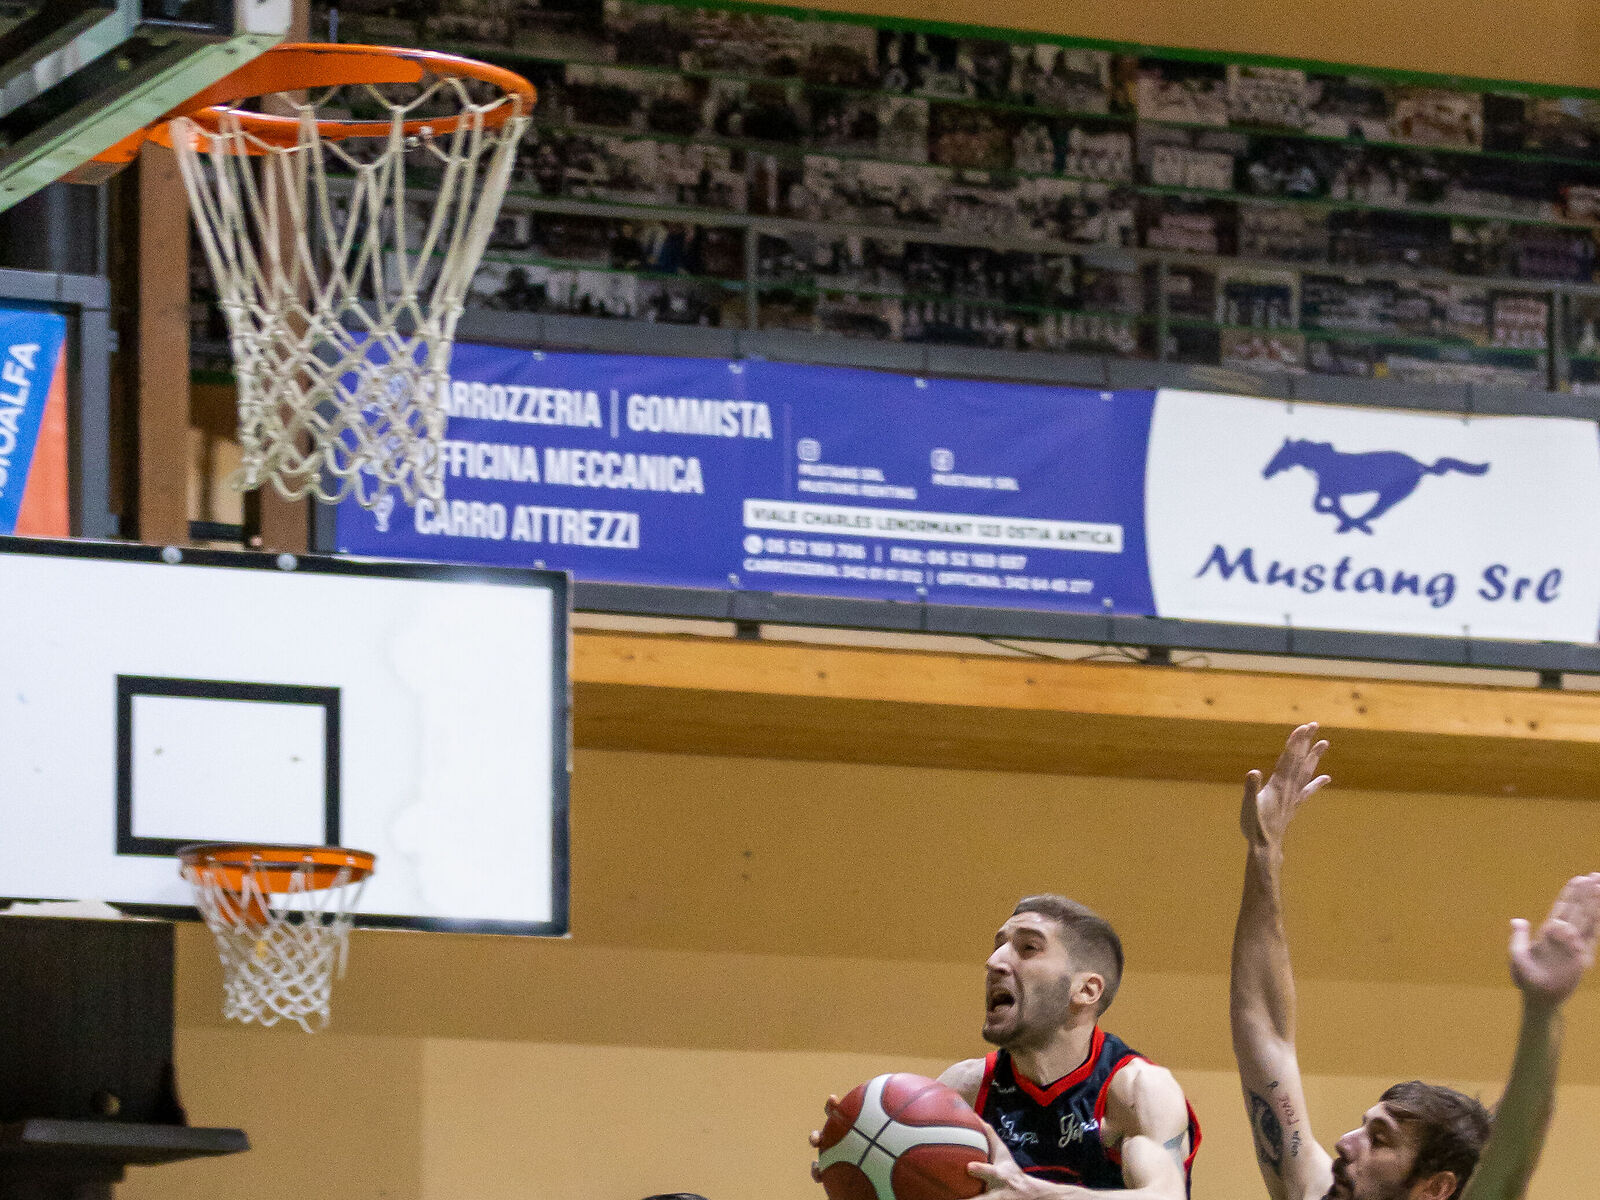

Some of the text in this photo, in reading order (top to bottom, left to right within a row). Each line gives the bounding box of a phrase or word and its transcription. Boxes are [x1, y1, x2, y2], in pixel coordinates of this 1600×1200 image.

[627, 394, 773, 439] GOMMISTA
[545, 449, 704, 494] MECCANICA
[415, 498, 640, 549] CARRO ATTREZZI
[753, 508, 796, 523] VIALE
[803, 511, 871, 529] CHARLES
[1008, 525, 1050, 540] OSTIA
[1059, 529, 1113, 544] ANTICA
[1195, 544, 1563, 608] Mustang Srl
